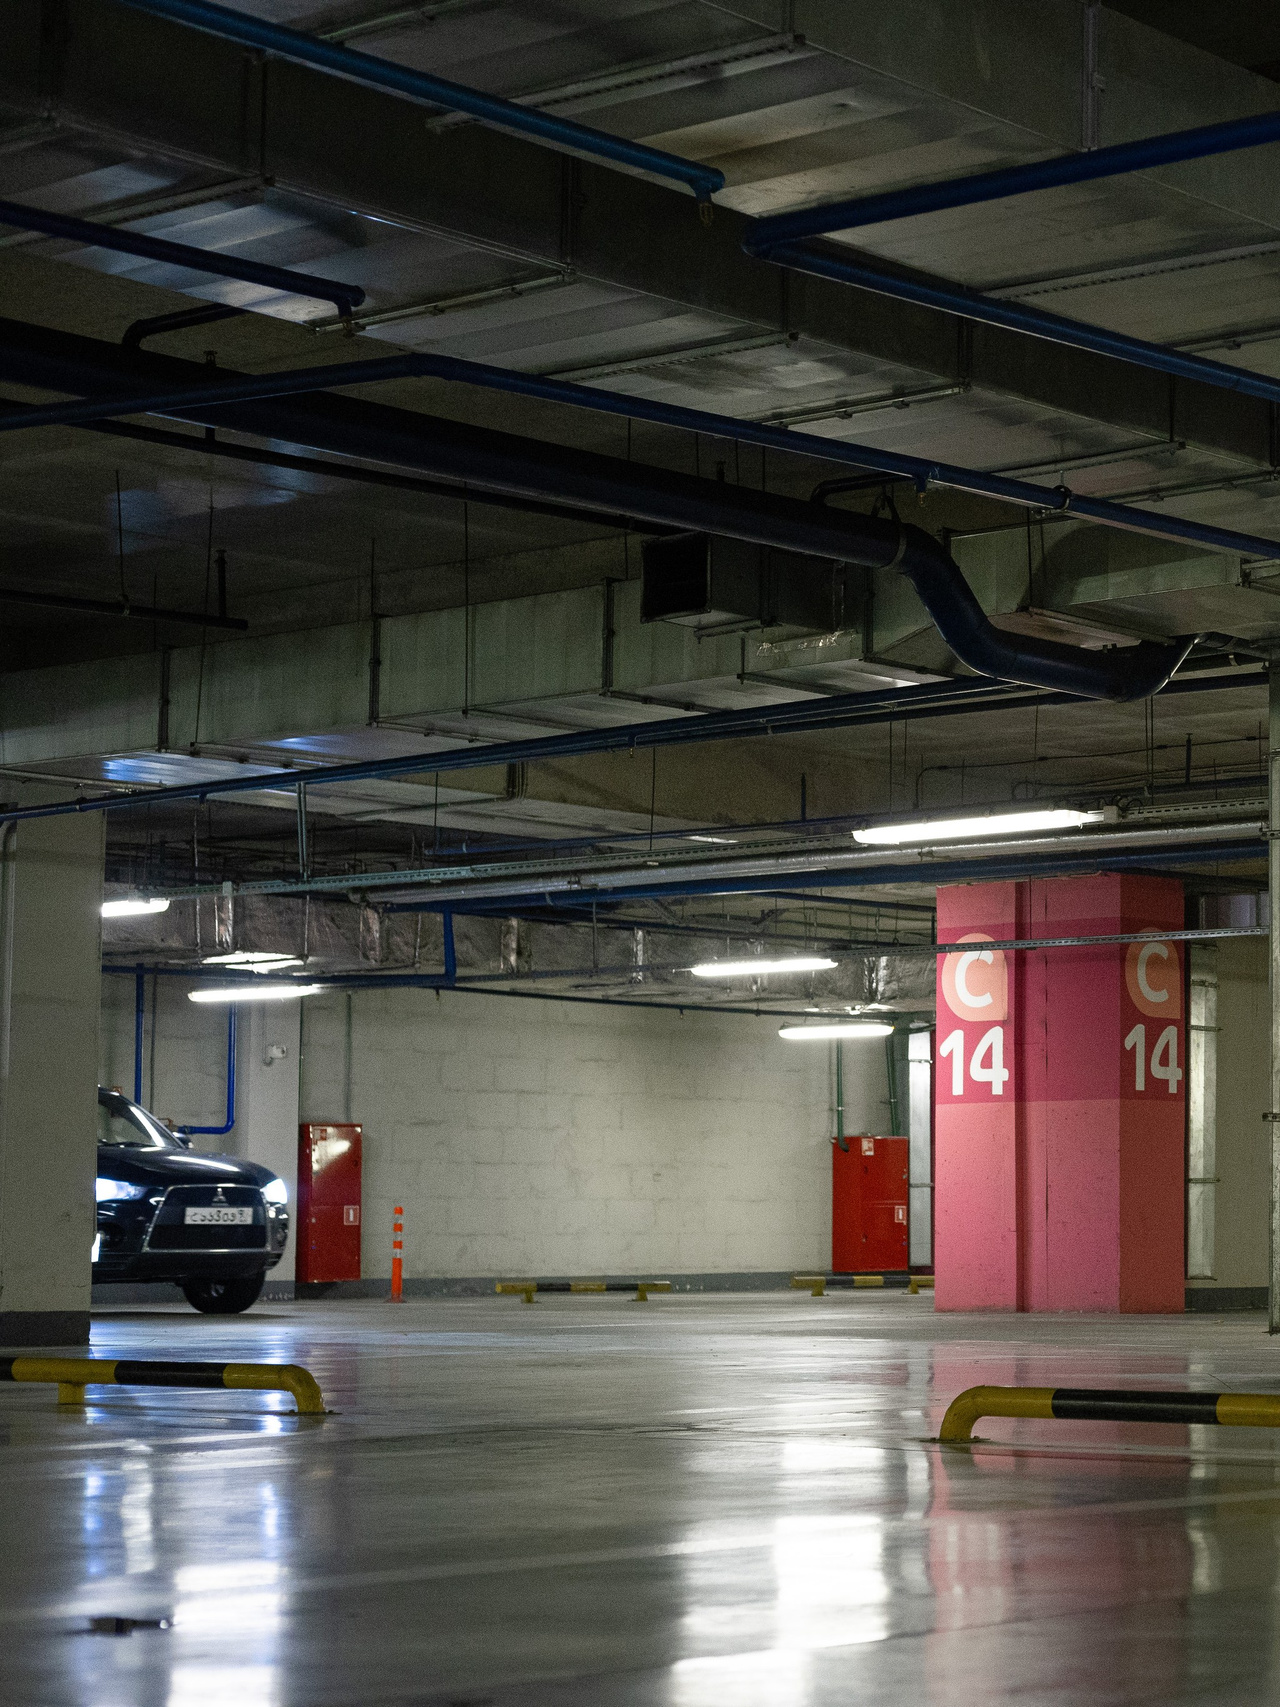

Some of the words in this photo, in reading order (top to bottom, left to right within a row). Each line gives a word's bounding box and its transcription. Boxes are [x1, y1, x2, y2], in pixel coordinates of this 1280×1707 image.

[955, 949, 994, 1008] C
[1137, 942, 1169, 1003] C
[940, 1026, 1009, 1095] 14
[1125, 1024, 1183, 1093] 14
